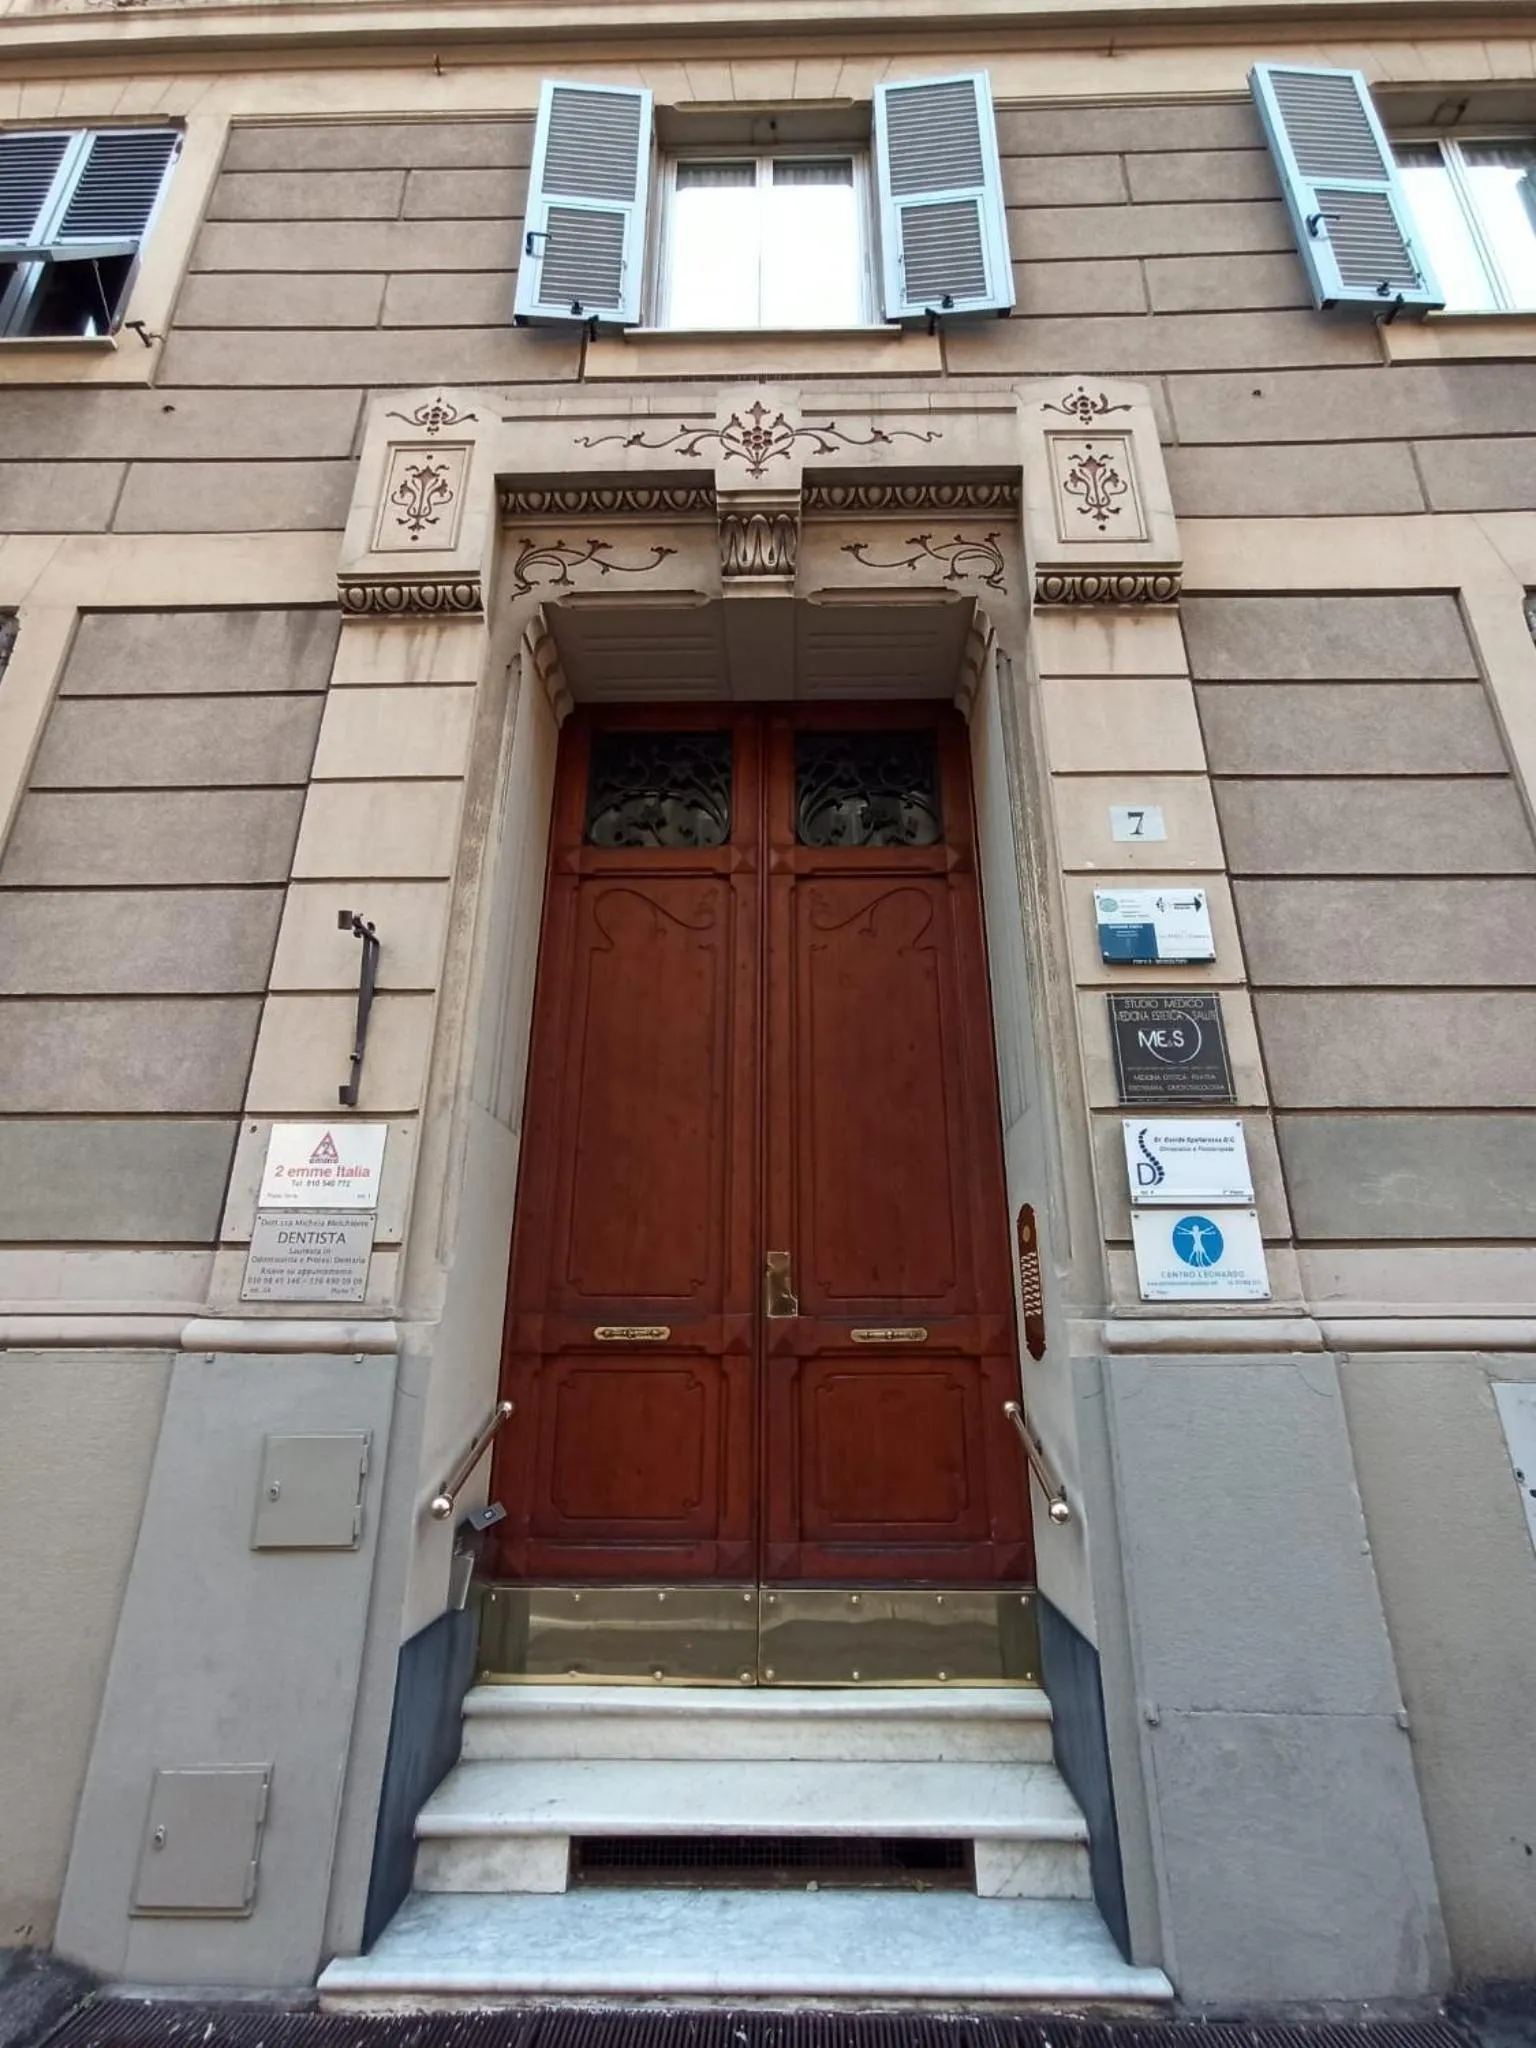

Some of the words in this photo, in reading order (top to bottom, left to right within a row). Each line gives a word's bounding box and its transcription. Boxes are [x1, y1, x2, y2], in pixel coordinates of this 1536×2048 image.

[1127, 811, 1145, 835] 7
[1124, 1000, 1158, 1009] STUDIO
[274, 1165, 285, 1178] 2
[287, 1168, 332, 1178] emme
[336, 1165, 371, 1178] Italia
[278, 1231, 347, 1245] DENTISTA
